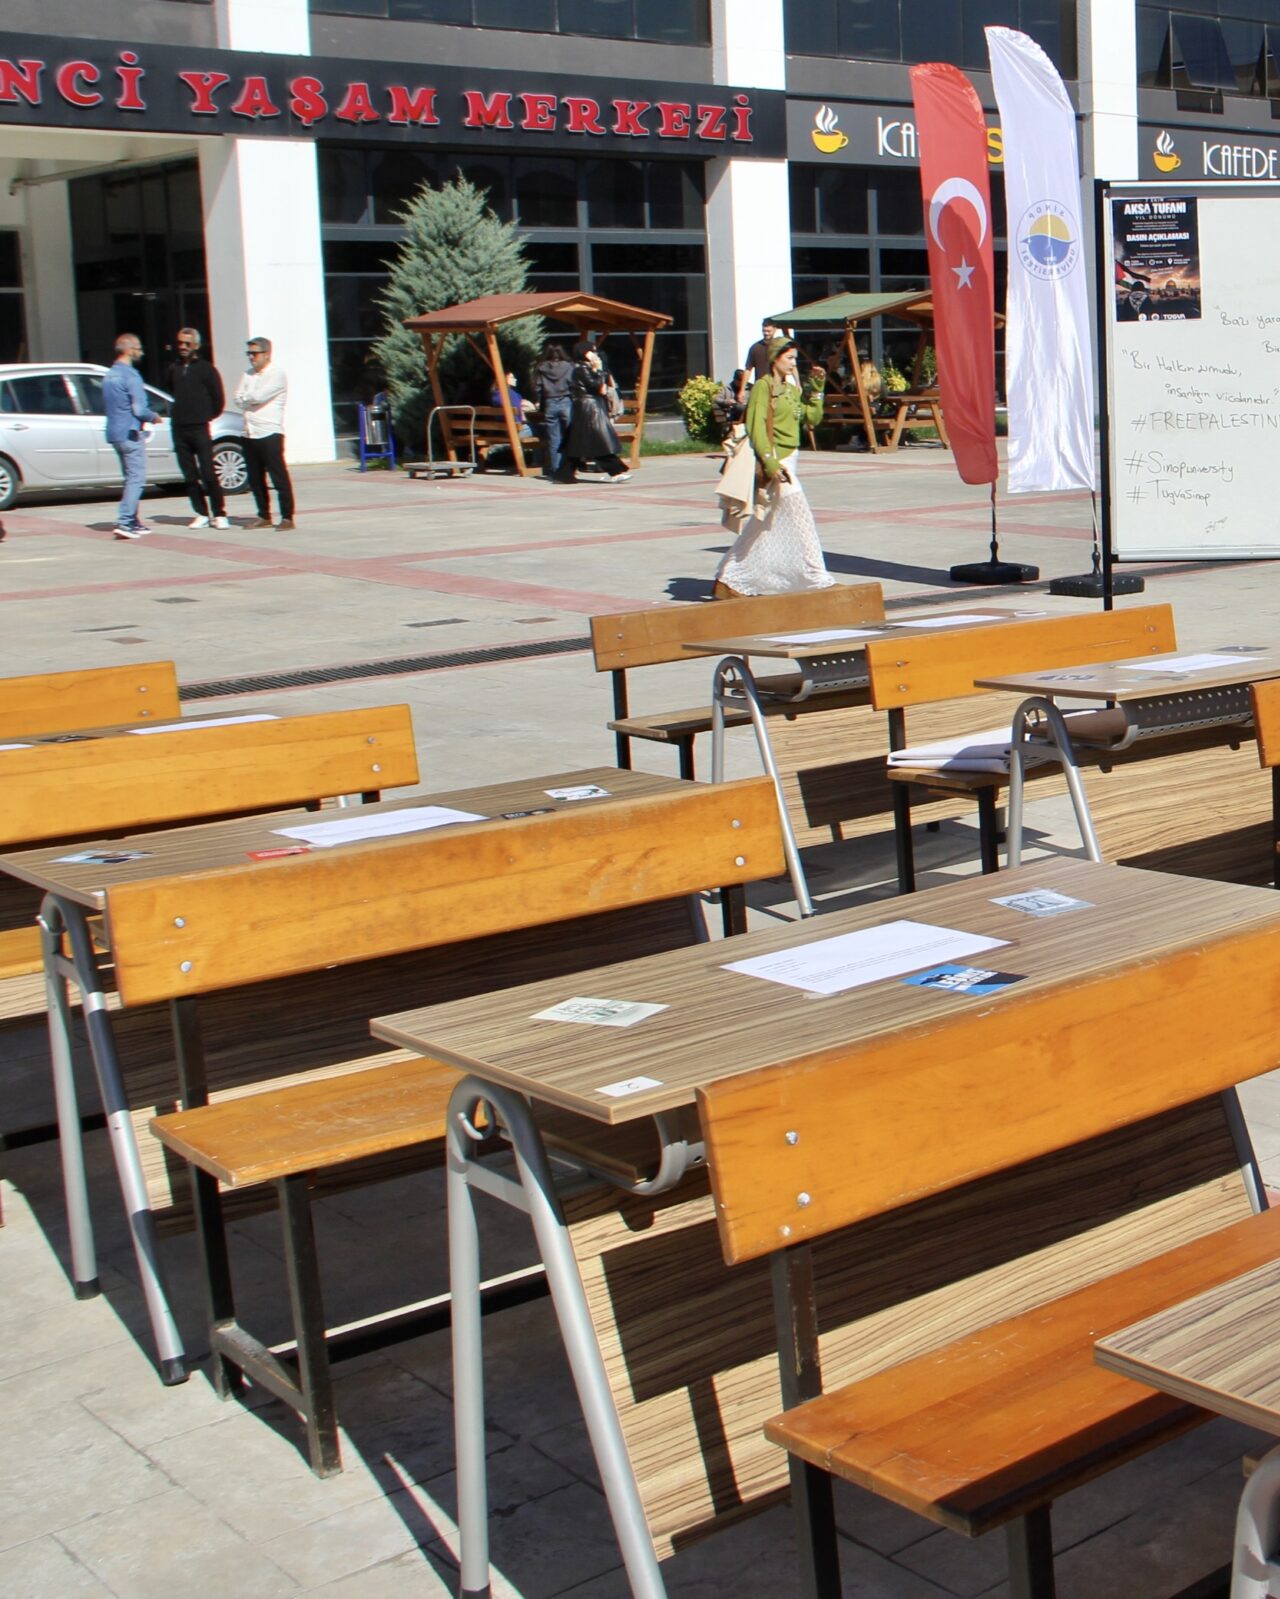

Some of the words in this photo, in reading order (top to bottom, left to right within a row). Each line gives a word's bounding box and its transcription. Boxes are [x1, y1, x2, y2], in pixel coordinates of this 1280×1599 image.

[179, 71, 440, 127] YAŞAM
[463, 91, 755, 143] MERKEZİ
[1124, 203, 1151, 215] AKSA
[1152, 202, 1187, 214] TUFANI
[1126, 233, 1147, 242] BASIN
[1148, 232, 1190, 243] AÇIKLAMASI
